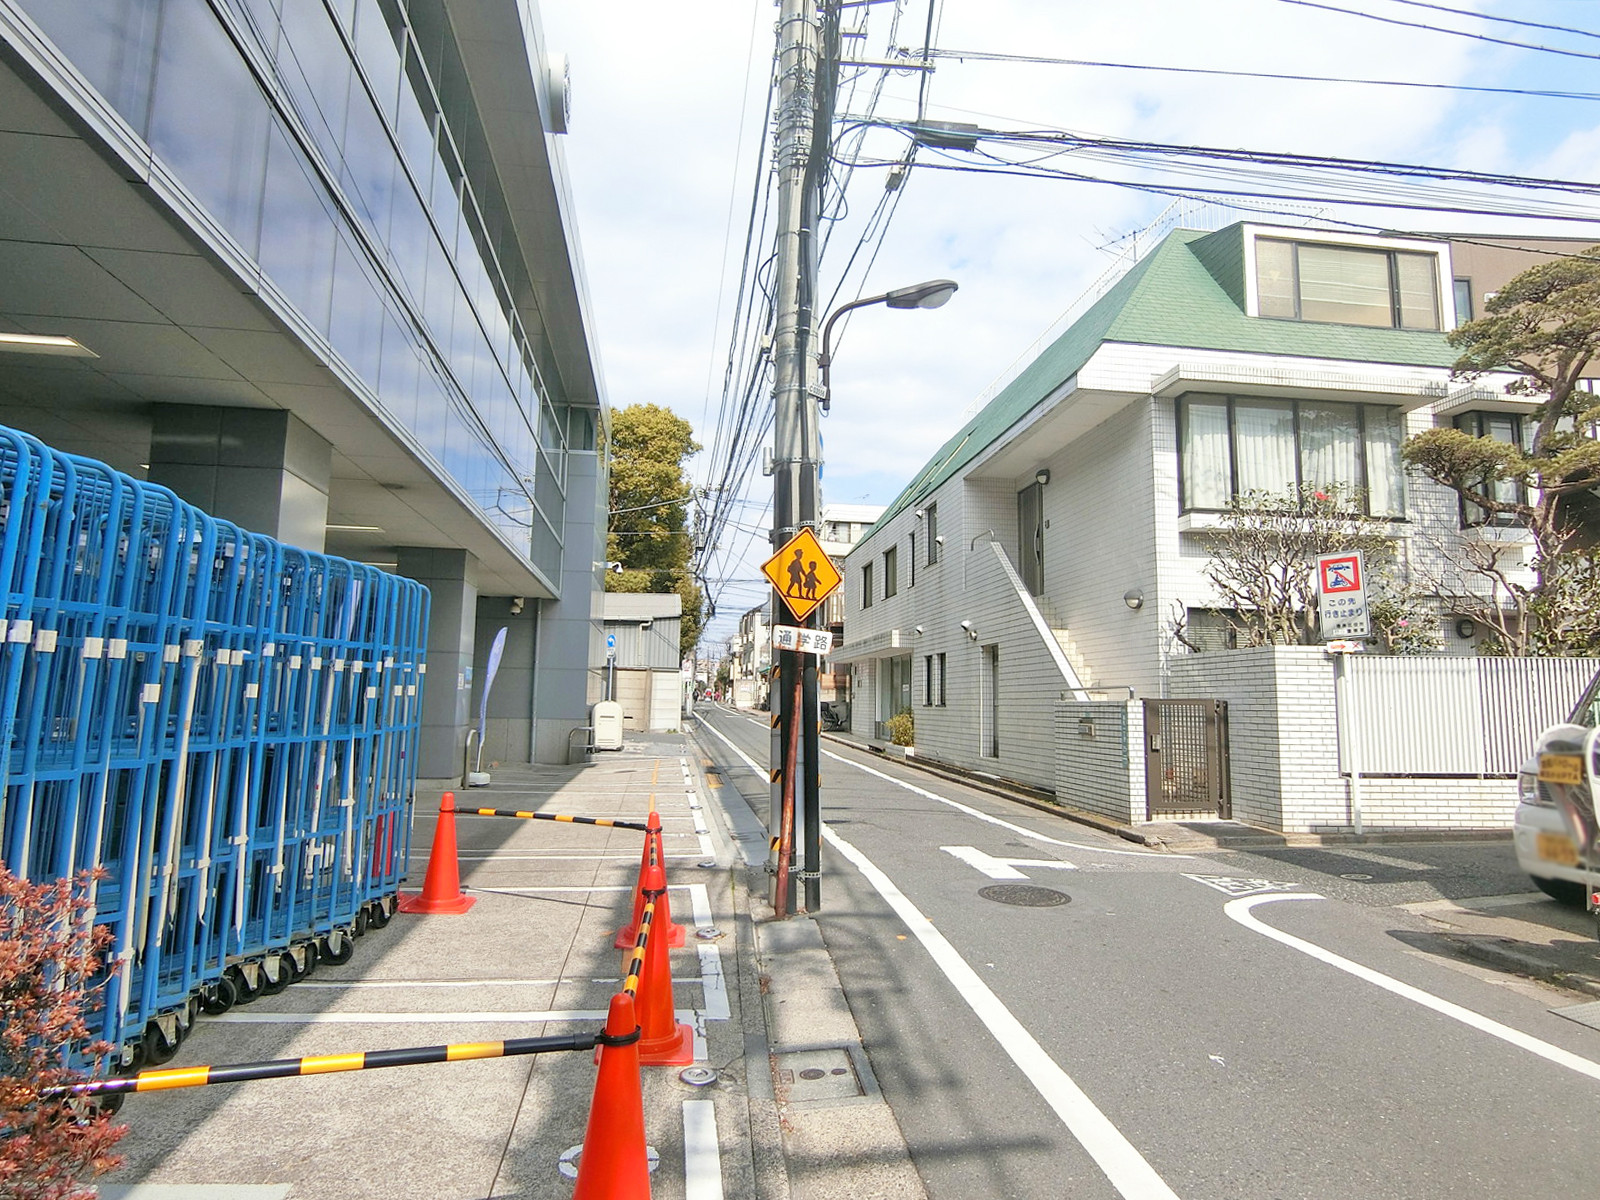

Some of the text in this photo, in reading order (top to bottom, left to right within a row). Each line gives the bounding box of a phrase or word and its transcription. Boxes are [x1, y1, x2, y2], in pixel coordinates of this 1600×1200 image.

[1328, 597, 1357, 607] この先
[1324, 607, 1363, 619] 行き止まり
[778, 629, 829, 651] 通学路
